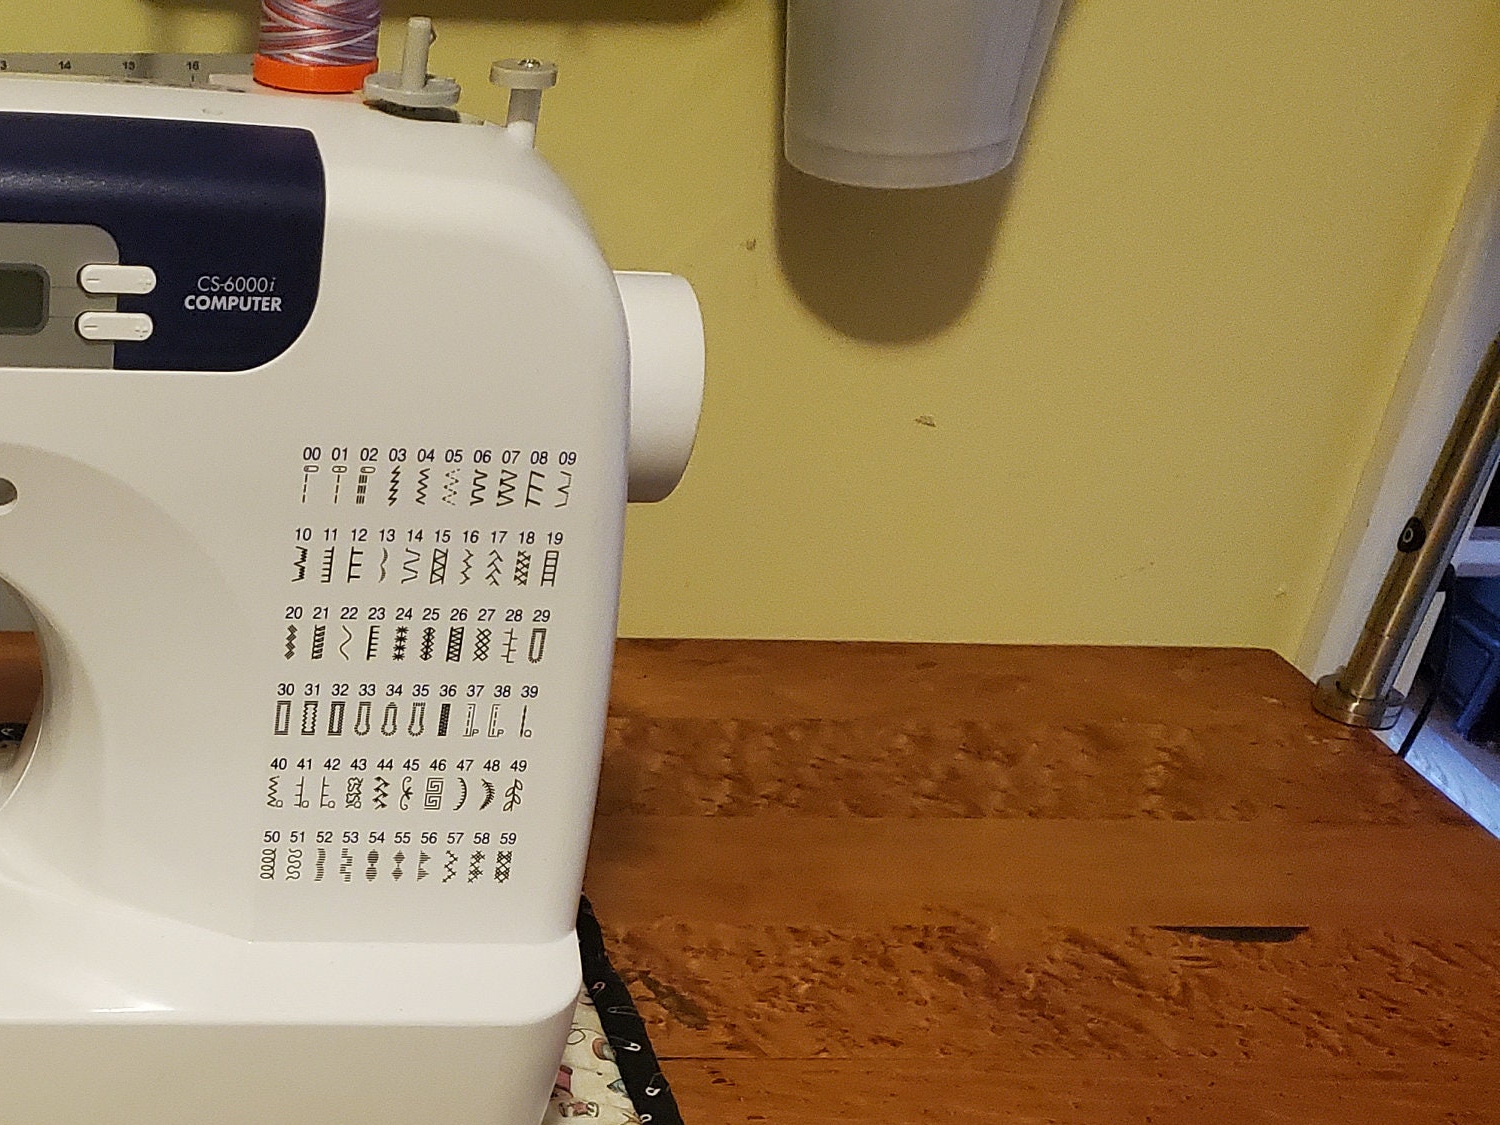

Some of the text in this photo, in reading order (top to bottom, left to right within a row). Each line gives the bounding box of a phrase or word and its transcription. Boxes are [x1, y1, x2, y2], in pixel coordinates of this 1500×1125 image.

[58, 60, 72, 70] 14
[186, 61, 200, 70] 16
[197, 275, 277, 293] CS-6000i
[184, 295, 283, 312] COMPUTER
[302, 446, 578, 466] 00 01 02 03 04 05 06 07 08 09
[295, 527, 564, 546] 10 11 12 13 14 15 16 17 18 19
[284, 605, 551, 623] 20 21 22 23 24 25 26 27 28 29
[276, 682, 539, 699] 30 31 32 33 34 35 36 37 38 39
[269, 757, 528, 773] 40 41 42 43 44 45 46 47 48 49
[263, 830, 517, 846] 50 51 52 53 54 55 56 57 58 59
